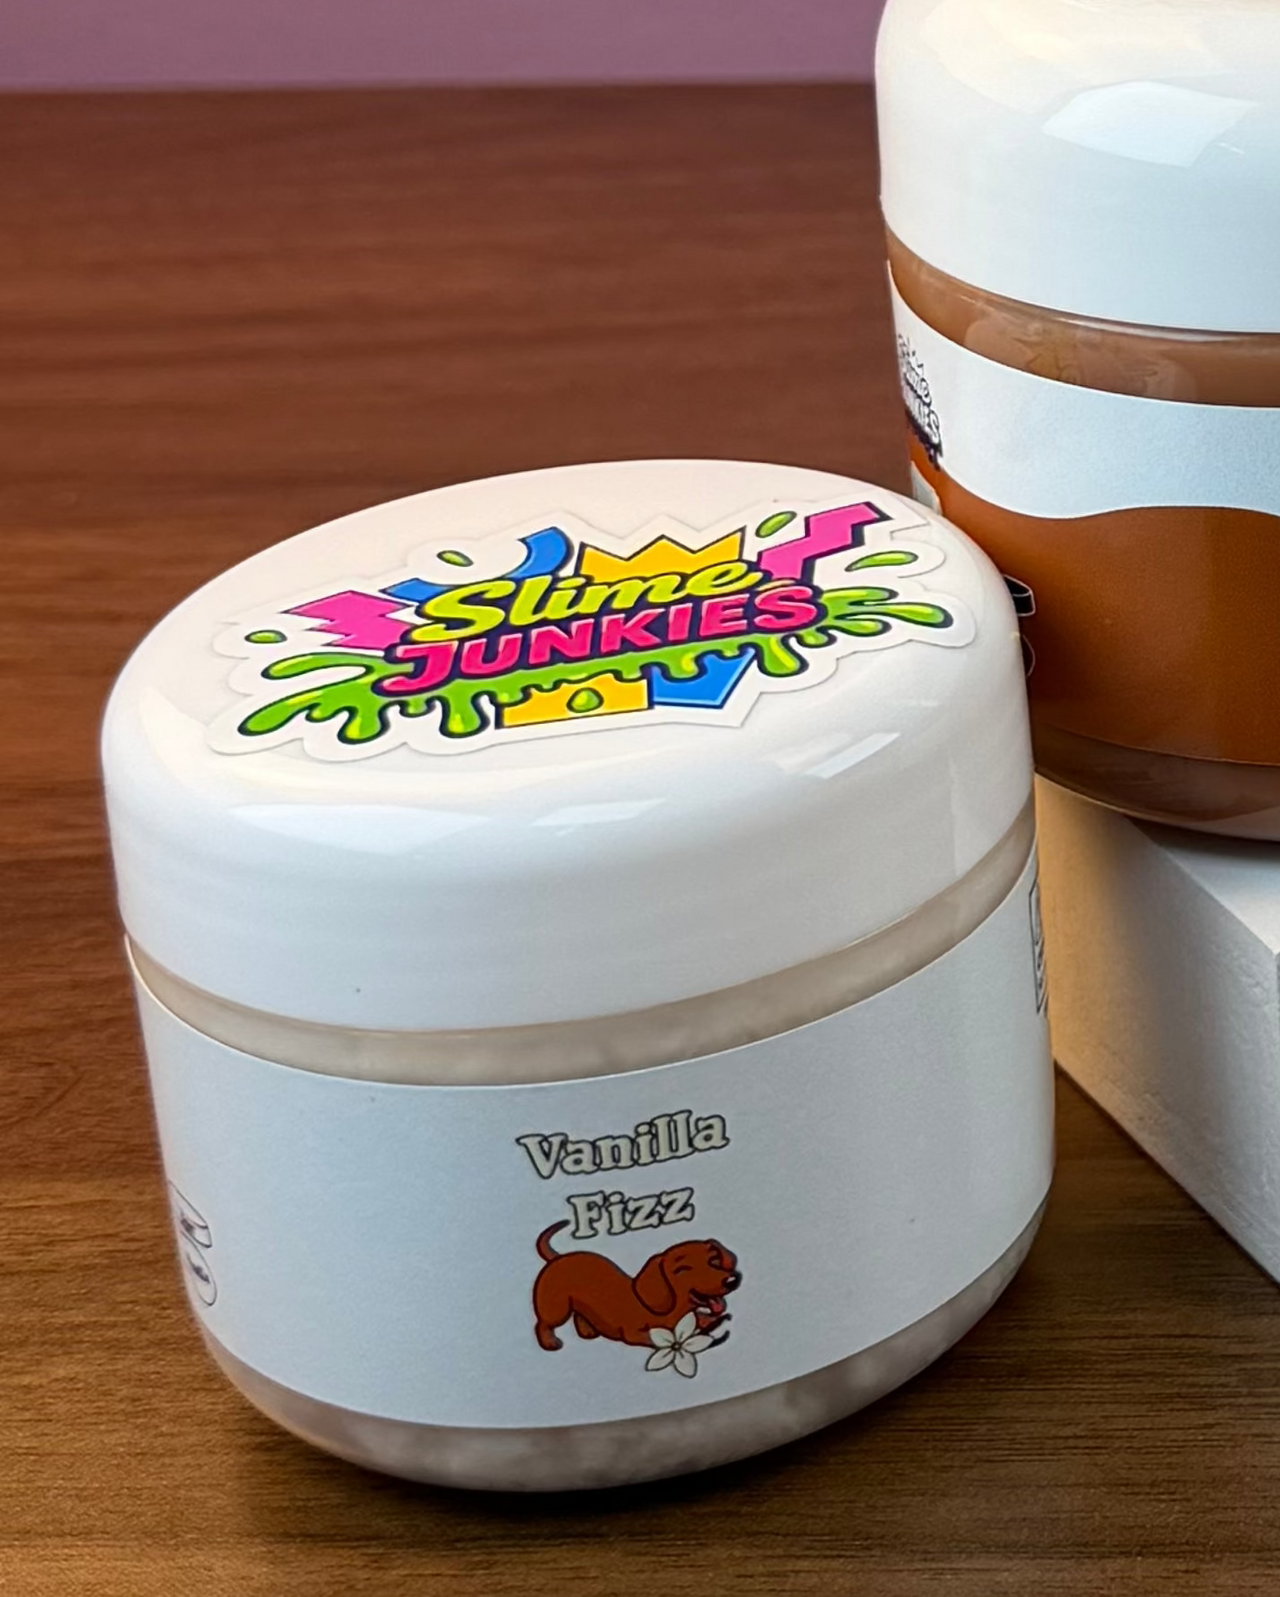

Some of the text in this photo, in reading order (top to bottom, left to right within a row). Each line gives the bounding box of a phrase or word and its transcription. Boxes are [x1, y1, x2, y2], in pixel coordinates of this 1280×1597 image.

[374, 582, 822, 696] JUNKIES
[409, 557, 762, 644] Slime
[515, 1109, 730, 1180] Vanilla
[566, 1187, 696, 1239] Fizz
